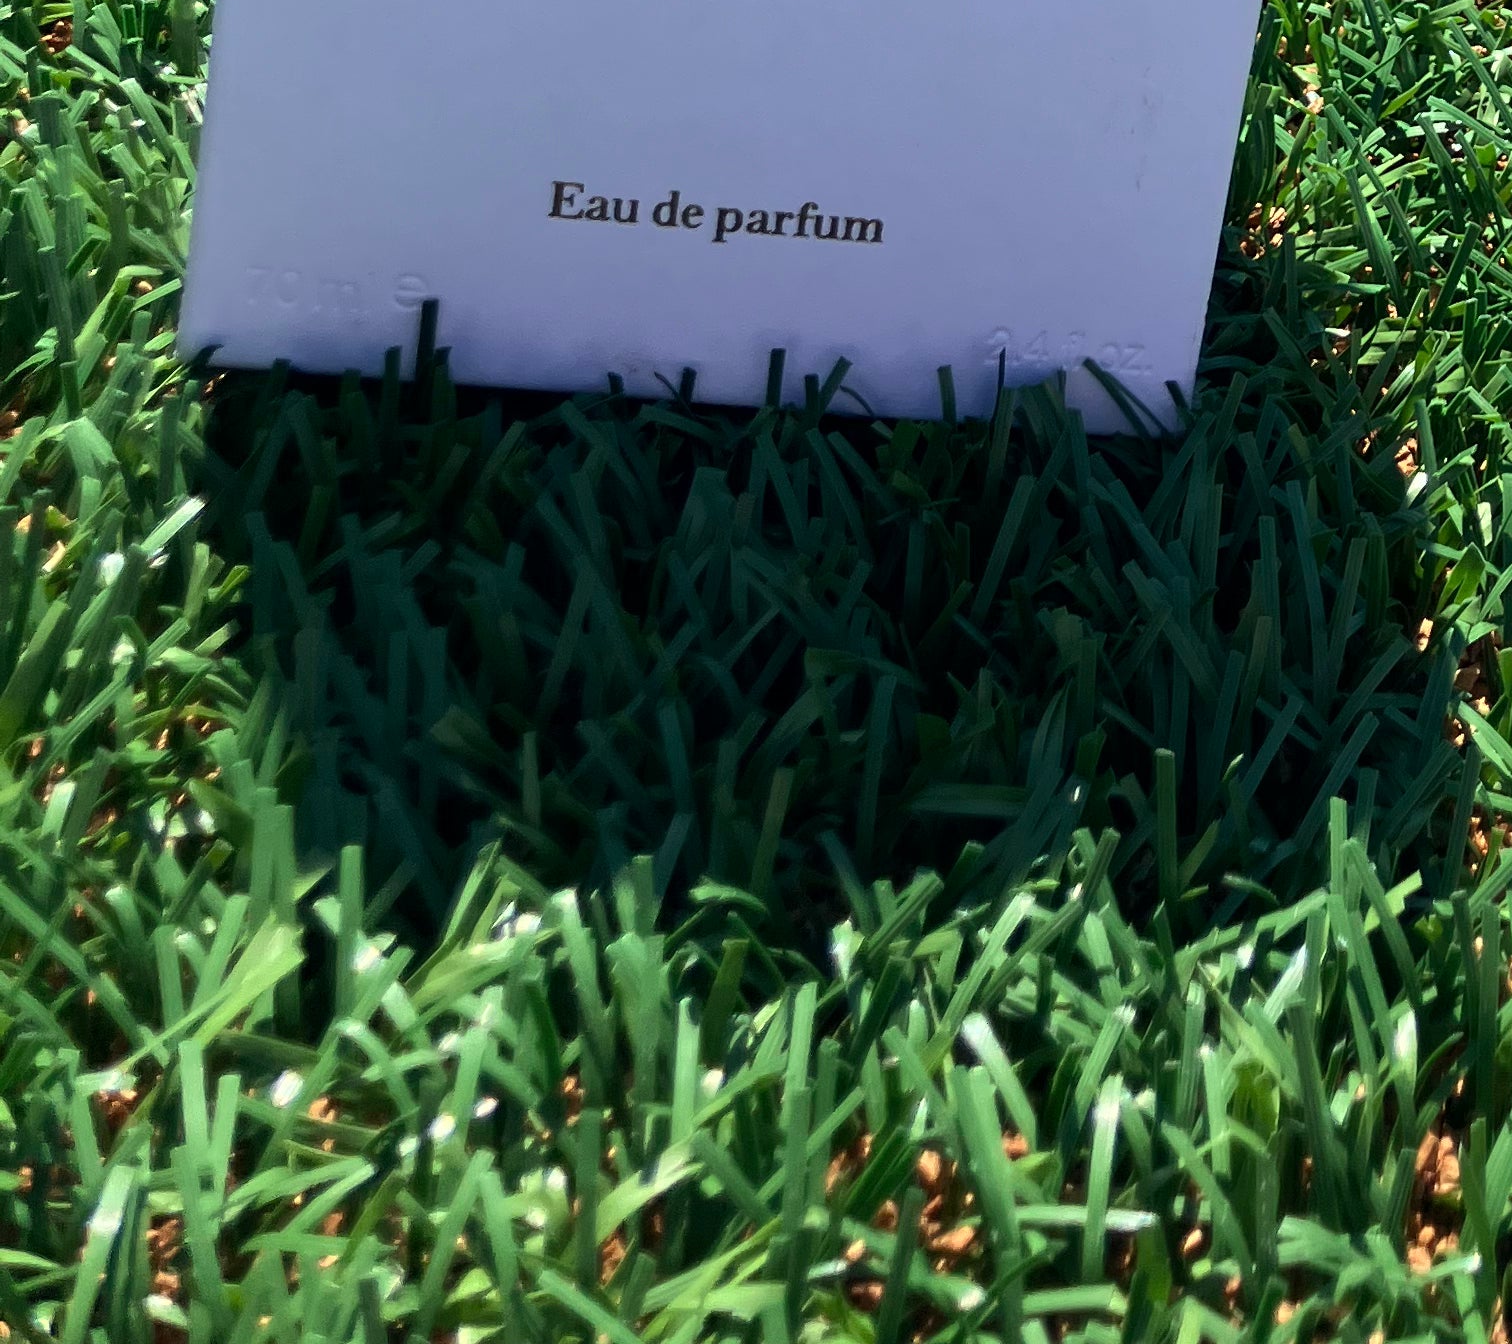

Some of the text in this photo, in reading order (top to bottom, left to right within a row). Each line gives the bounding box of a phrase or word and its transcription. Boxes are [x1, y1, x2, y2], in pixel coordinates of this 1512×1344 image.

[548, 180, 884, 244] Eau de parfum
